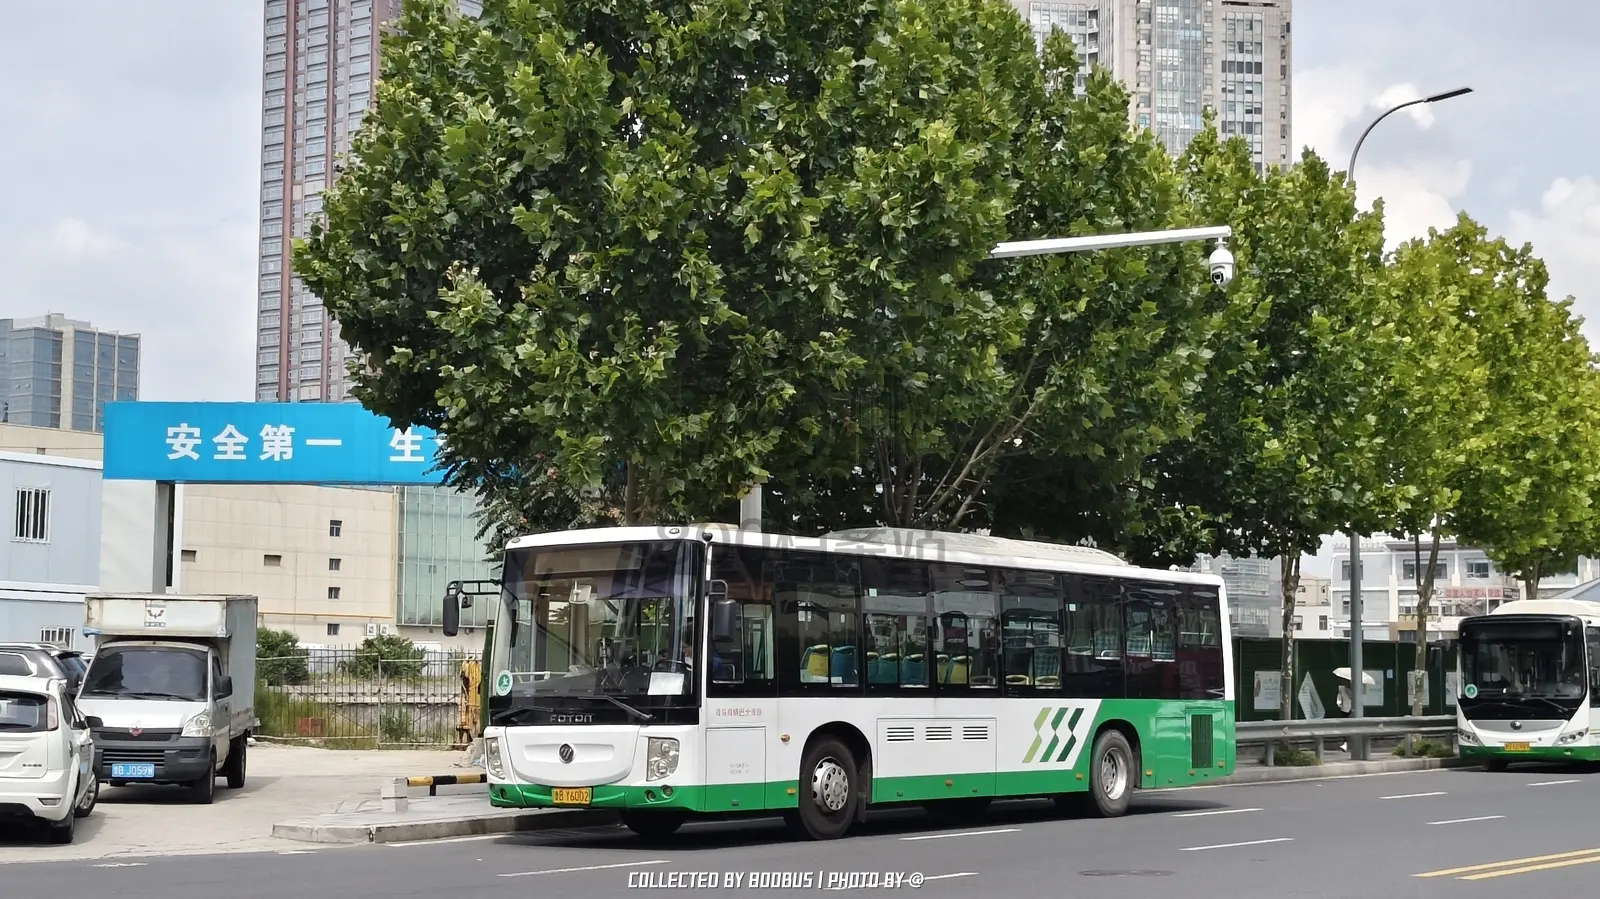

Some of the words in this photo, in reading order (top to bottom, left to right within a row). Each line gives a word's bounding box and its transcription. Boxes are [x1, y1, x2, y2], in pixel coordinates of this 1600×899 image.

[165, 423, 342, 462] 安全第一
[389, 426, 447, 463] 生
[549, 714, 593, 723] FOTON
